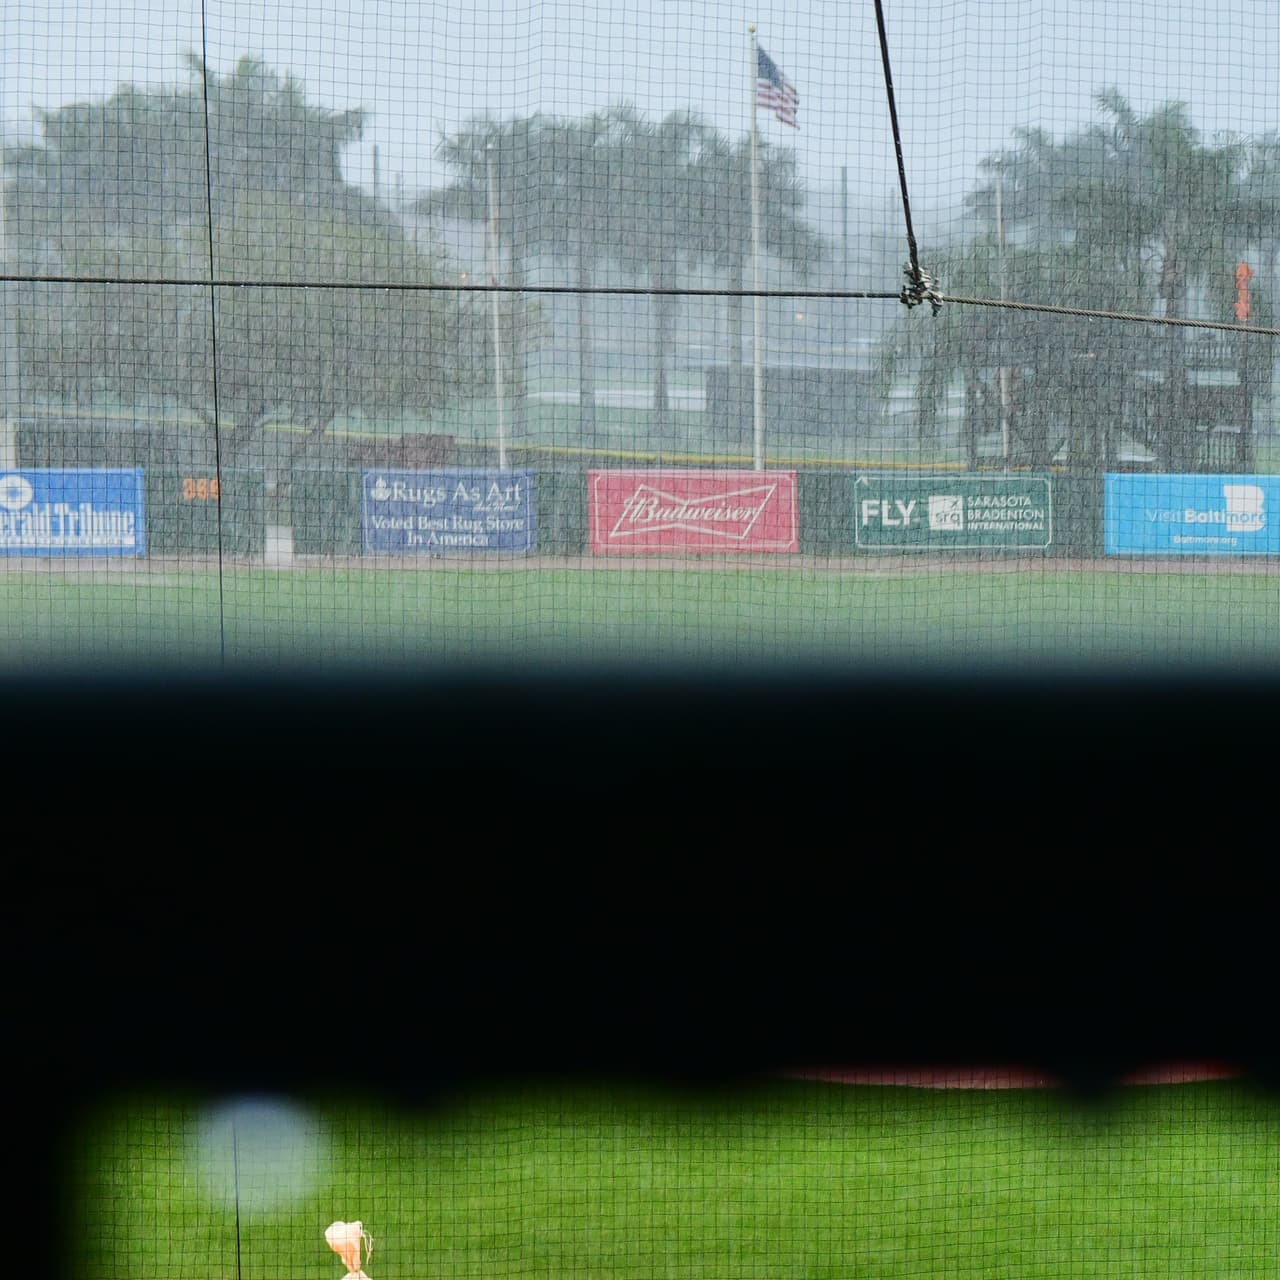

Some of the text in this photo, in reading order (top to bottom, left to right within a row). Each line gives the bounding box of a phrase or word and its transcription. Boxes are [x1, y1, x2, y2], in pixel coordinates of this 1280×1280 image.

[392, 480, 522, 508] Rugs As Art
[967, 495, 1032, 508] SARASOTA
[624, 496, 759, 524] Budweiser
[862, 500, 917, 526] FLY
[967, 508, 1045, 520] BRADENTON
[1146, 507, 1266, 525] Visit Baltimore
[371, 515, 525, 533] Voted Best Rug Store
[967, 521, 1045, 531] INTERNATIONAL
[407, 531, 490, 547] In America
[1172, 535, 1238, 546] Baltimore.org
